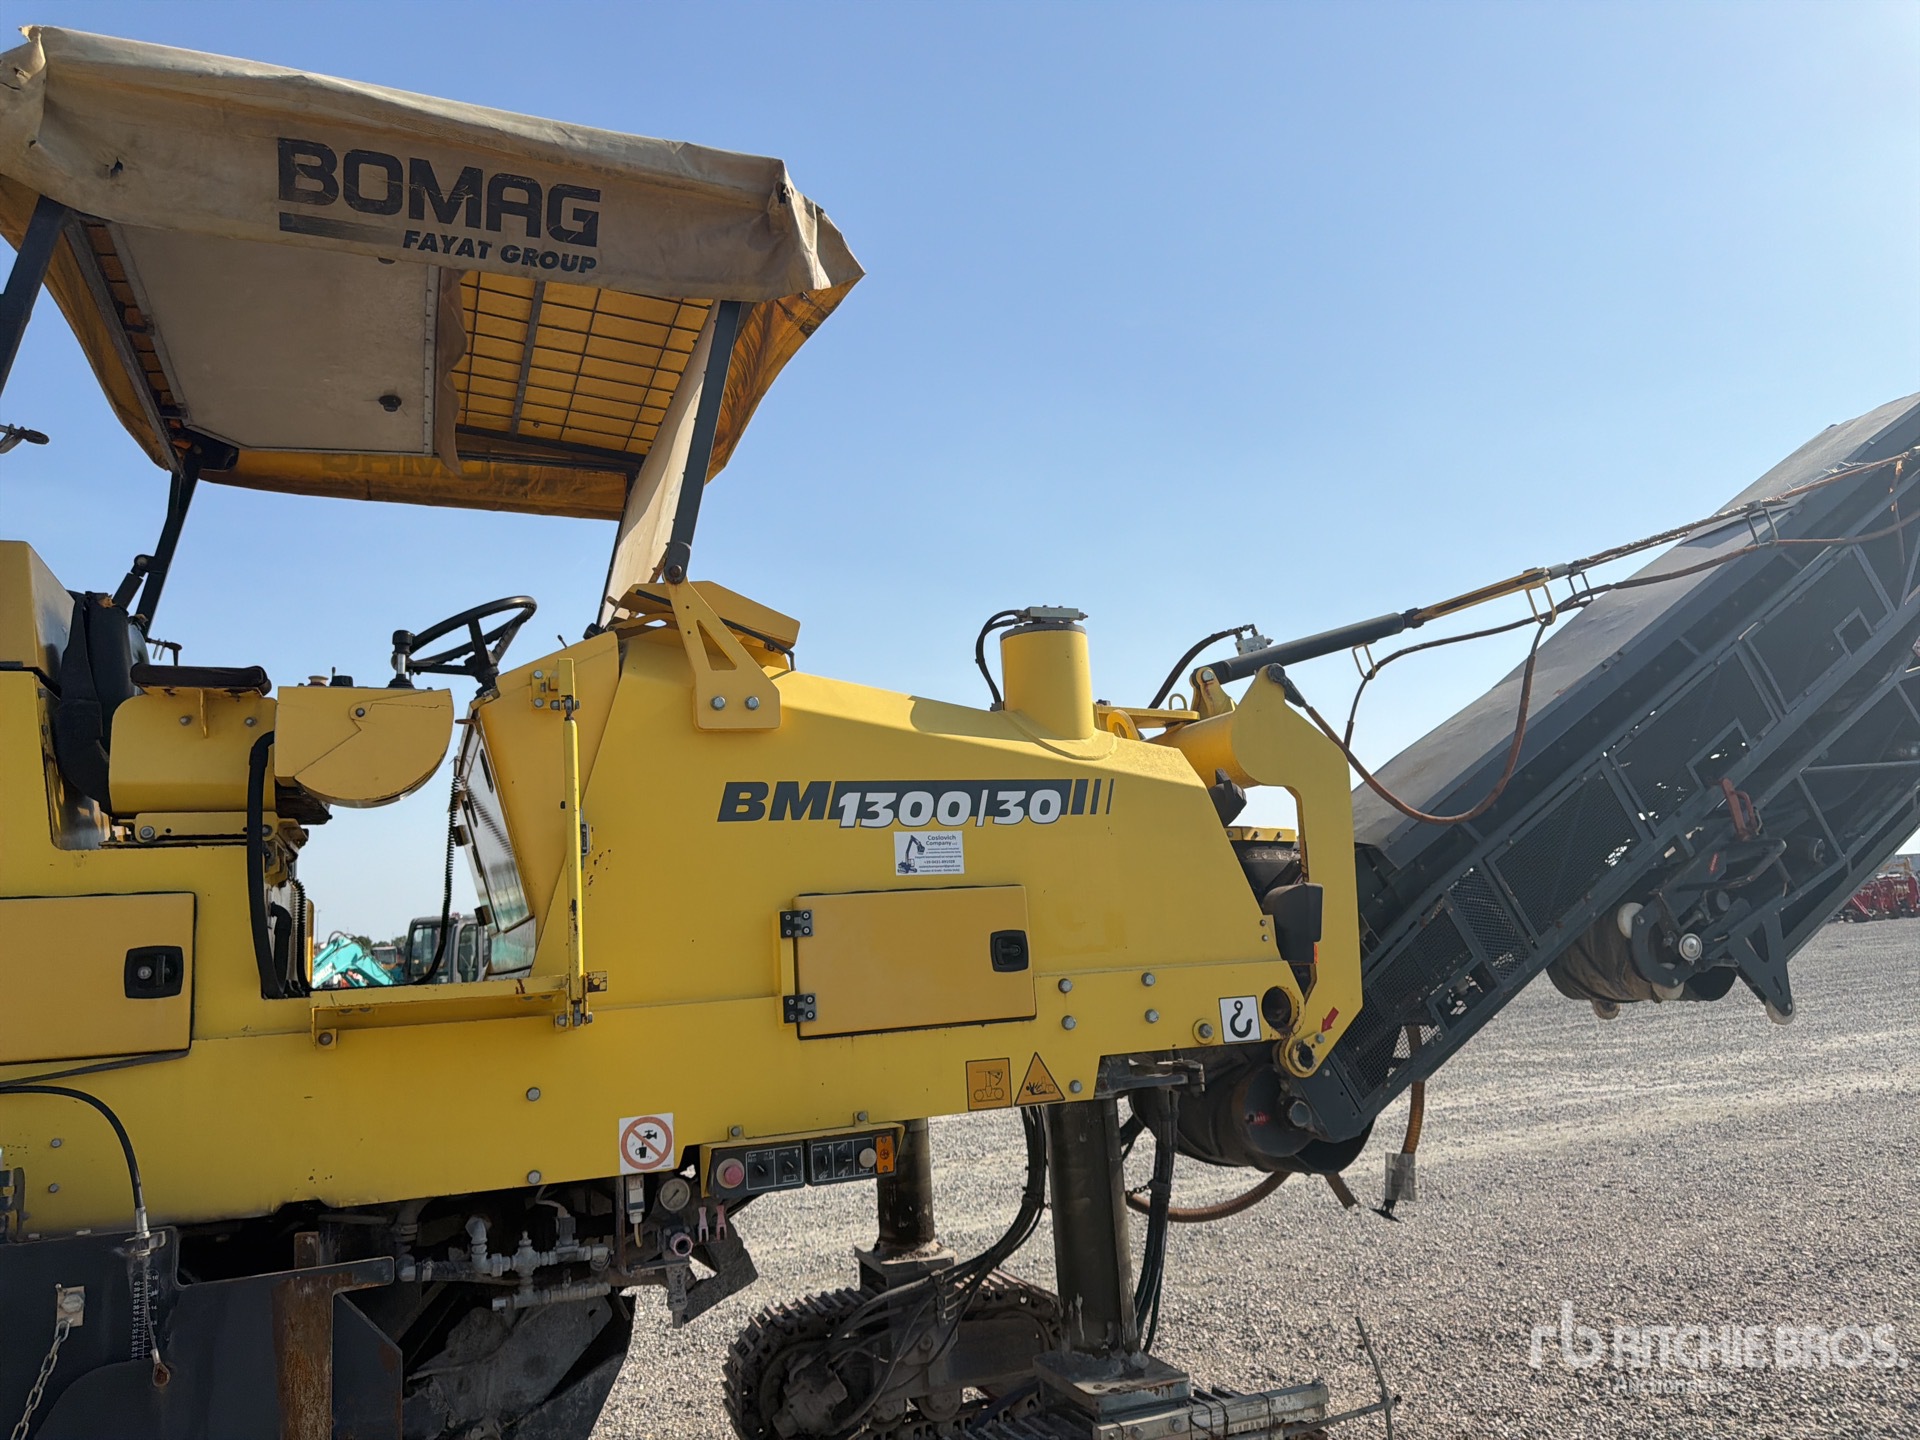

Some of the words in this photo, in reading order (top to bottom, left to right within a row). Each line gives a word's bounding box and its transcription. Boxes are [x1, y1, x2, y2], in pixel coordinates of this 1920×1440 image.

[277, 137, 601, 247] BOMAG
[403, 230, 492, 259] FAYAT
[500, 244, 597, 275] GROUP
[717, 781, 831, 822] BM
